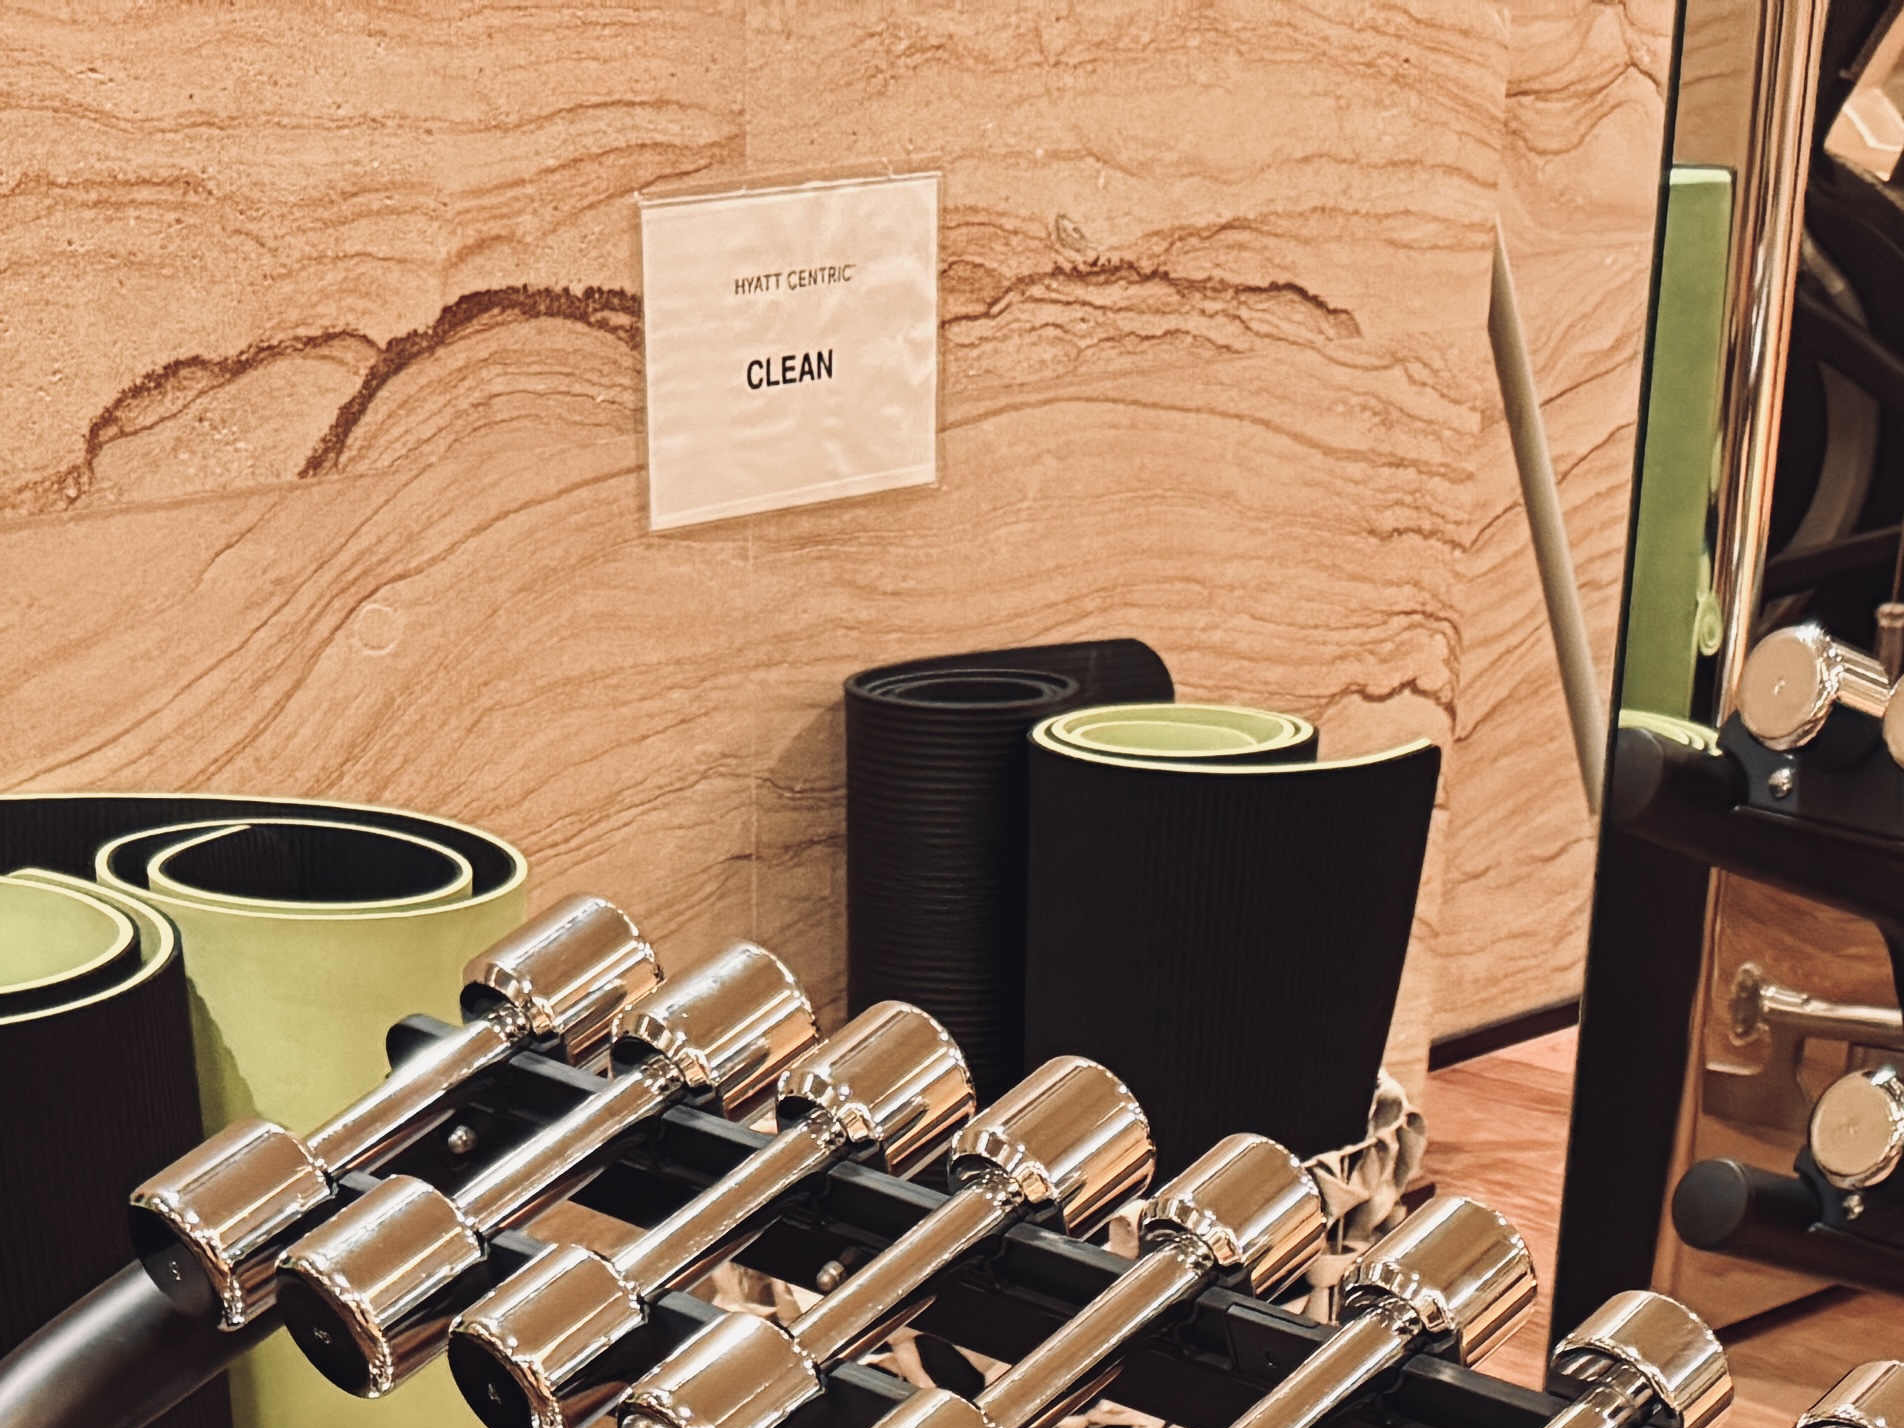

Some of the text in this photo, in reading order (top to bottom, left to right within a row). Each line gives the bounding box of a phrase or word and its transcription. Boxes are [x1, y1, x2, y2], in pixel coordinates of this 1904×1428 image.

[734, 264, 856, 295] HYATT CENTRIC
[746, 348, 834, 391] CLEAN
